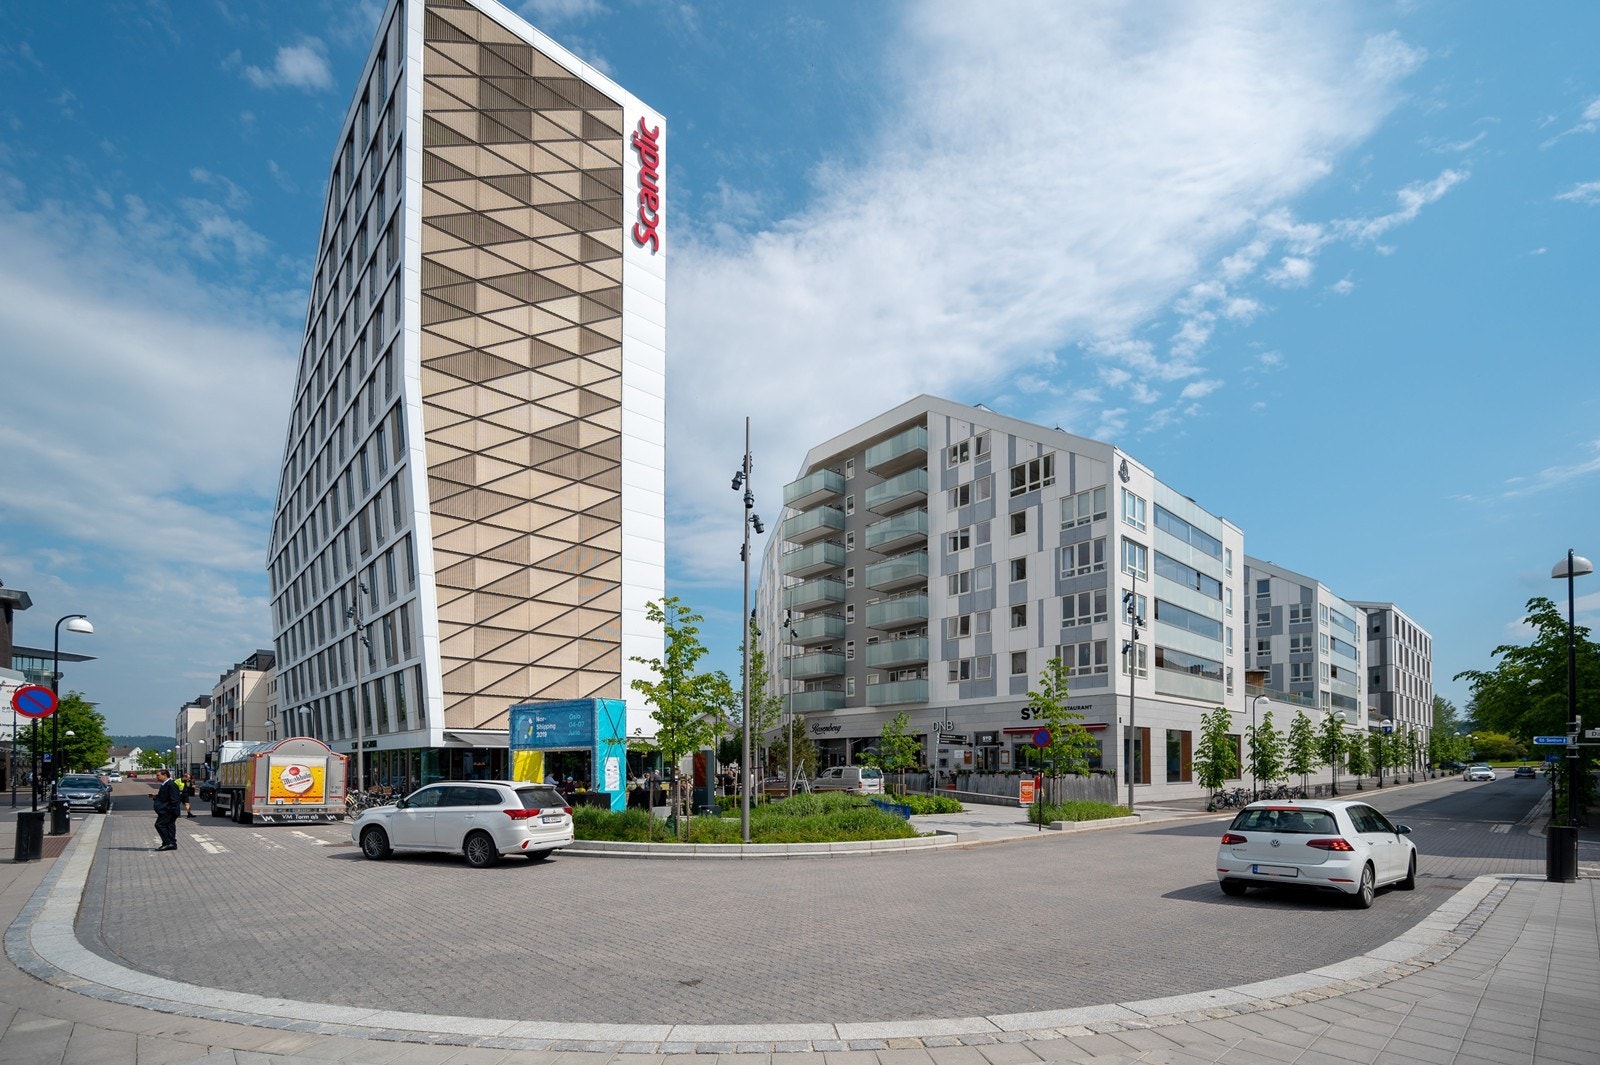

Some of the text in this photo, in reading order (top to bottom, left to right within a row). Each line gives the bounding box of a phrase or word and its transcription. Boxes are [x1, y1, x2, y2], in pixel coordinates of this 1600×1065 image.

[633, 116, 660, 253] Scandic
[1021, 706, 1052, 720] SY
[810, 722, 842, 736] Rosenberg
[932, 720, 954, 732] DNB
